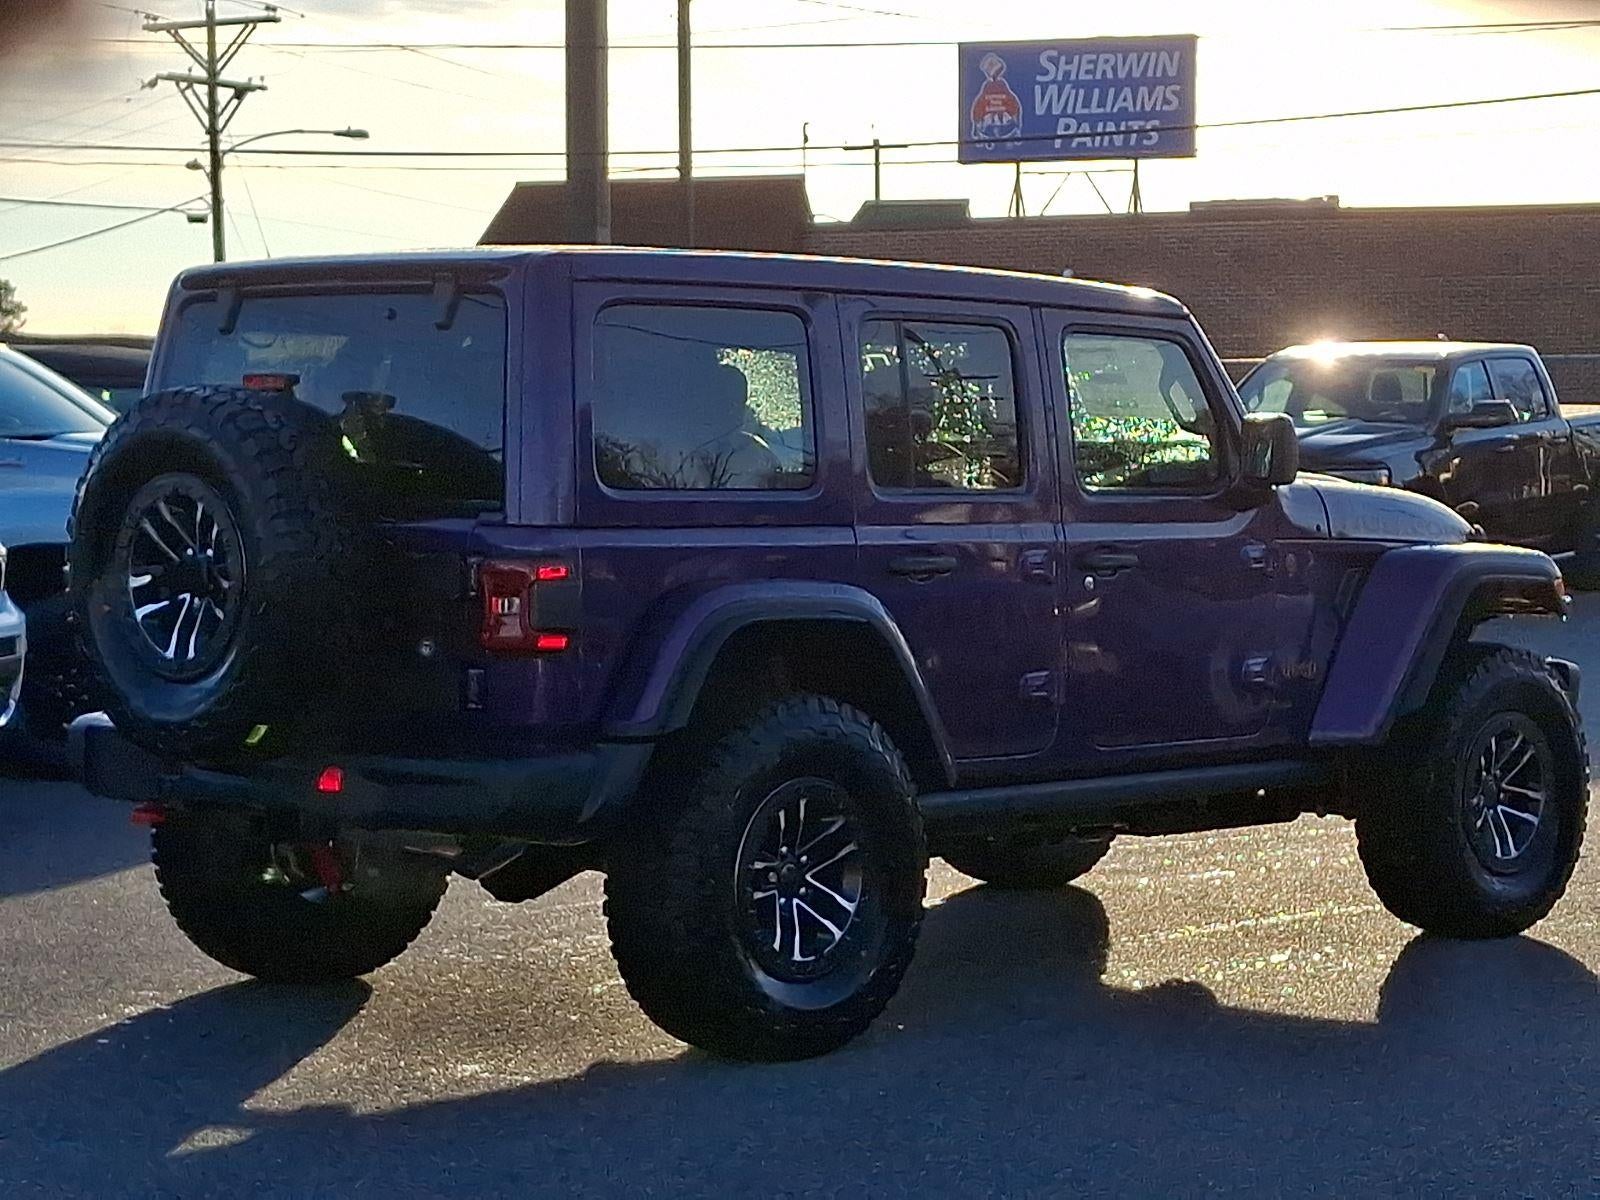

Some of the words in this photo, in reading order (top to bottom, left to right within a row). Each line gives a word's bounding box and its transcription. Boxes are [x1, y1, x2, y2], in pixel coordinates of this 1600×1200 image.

[1036, 50, 1180, 82] SHERWIN
[1034, 84, 1181, 115] WILLIAMS
[1054, 117, 1160, 148] PAINTS
